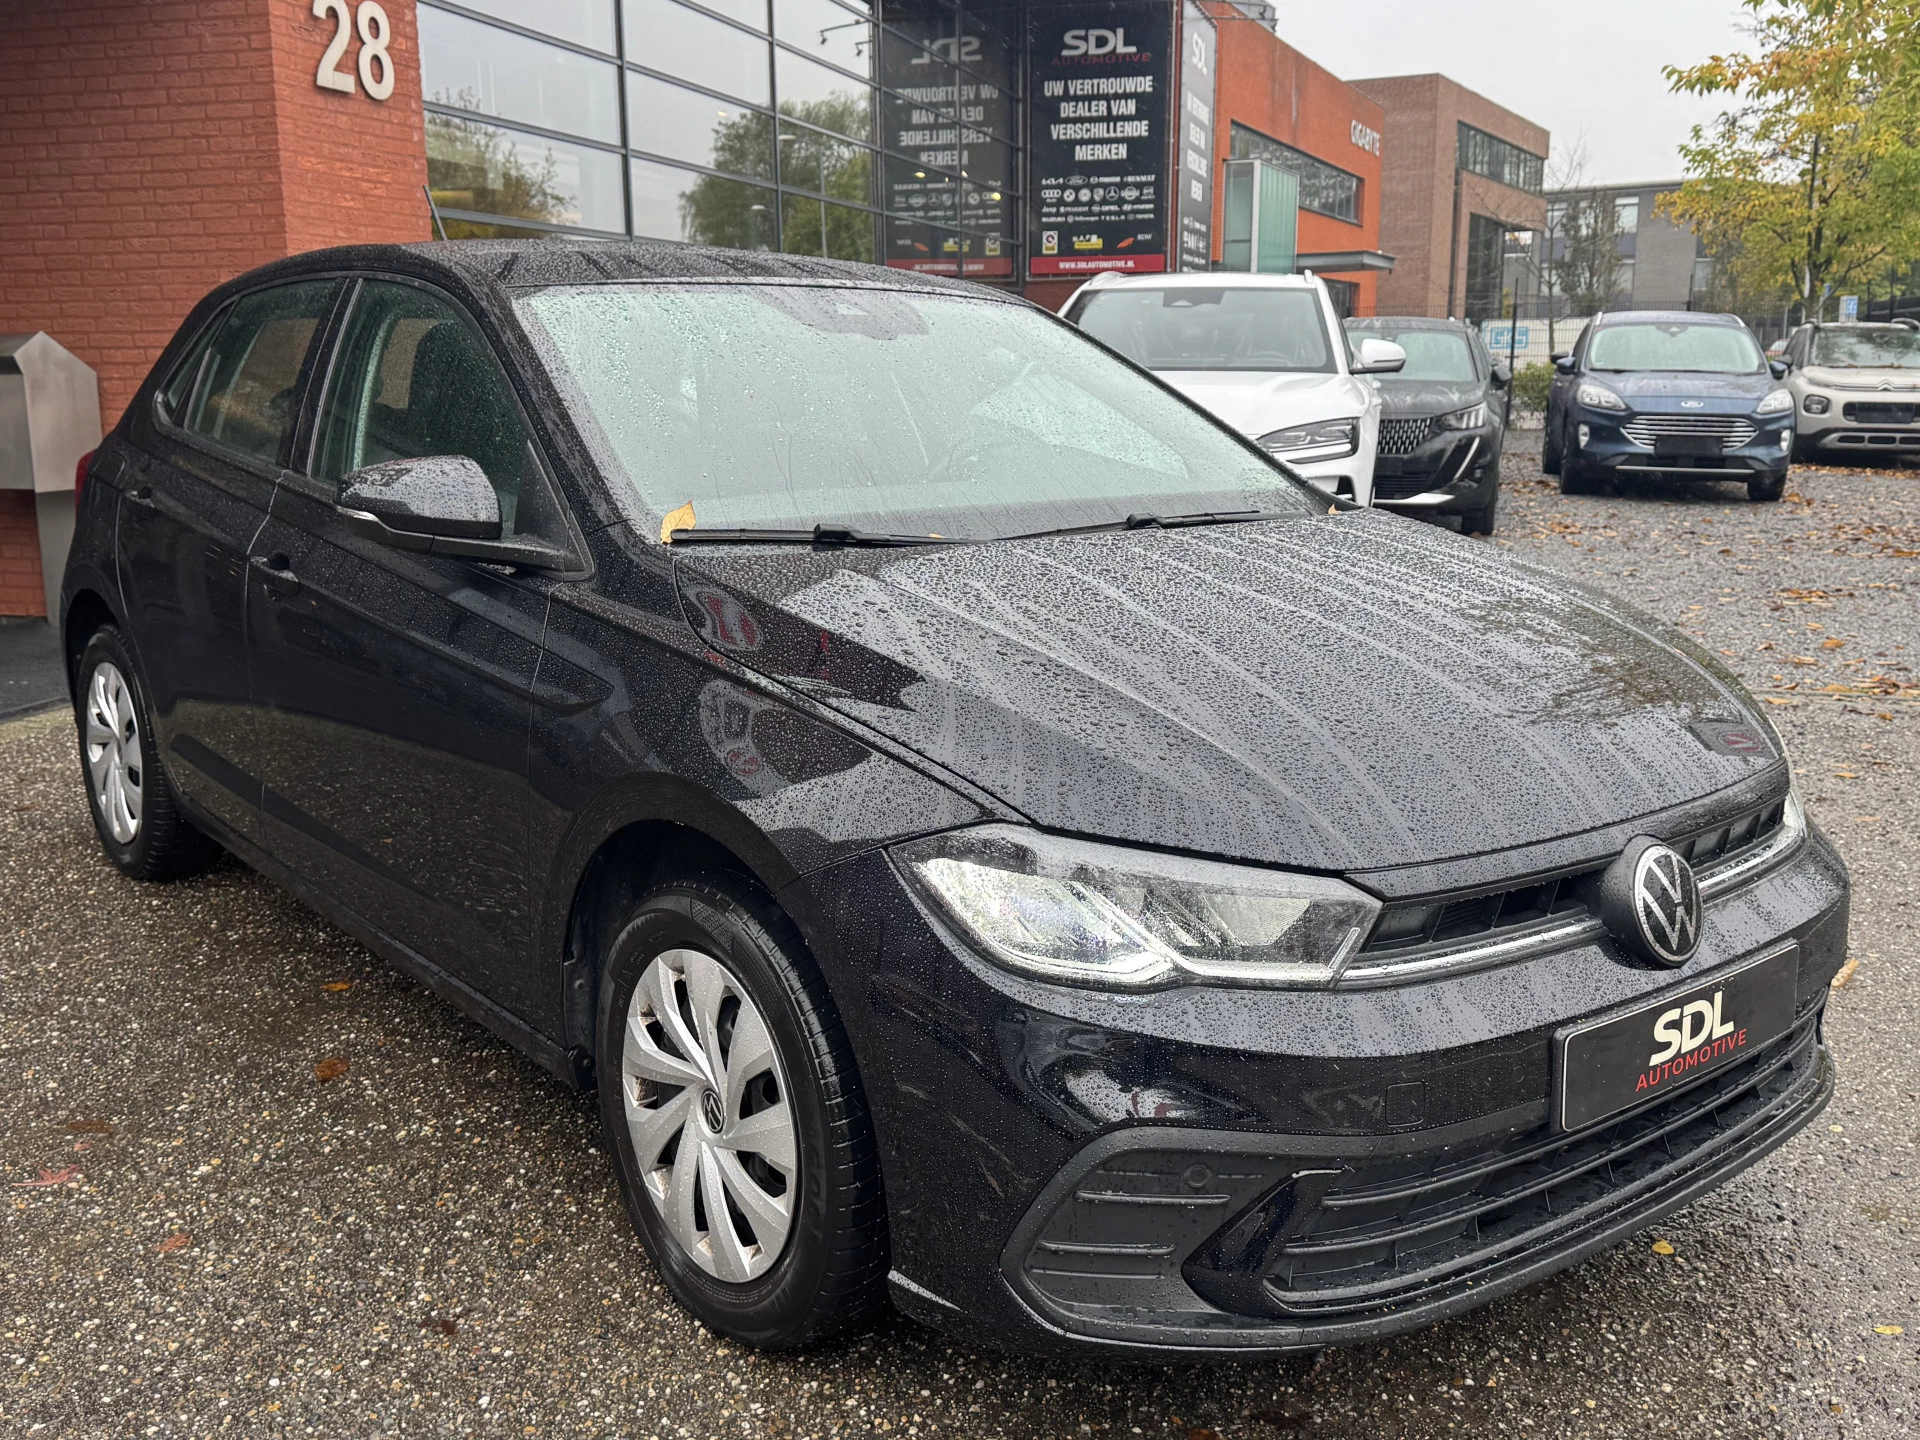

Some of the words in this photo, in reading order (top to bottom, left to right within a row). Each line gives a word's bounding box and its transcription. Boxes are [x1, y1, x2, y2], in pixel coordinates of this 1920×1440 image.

[312, 0, 395, 100] 28
[1061, 27, 1138, 56] SDL
[1051, 52, 1152, 67] AUTOMOTIVE
[1044, 80, 1065, 97] UW
[1068, 75, 1154, 96] VERTROUWDE
[1060, 100, 1108, 118] DEALER
[1111, 98, 1136, 116] VAN
[1050, 120, 1149, 140] VERSCHILLENDE
[1351, 119, 1380, 157] GIGABYTE
[1074, 143, 1127, 161] MERKEN
[1059, 260, 1135, 269] WWW.SDLAUTOMOTIVE.NL
[1649, 991, 1735, 1066] SDL
[1635, 1028, 1747, 1092] AUTOMOTIVE
